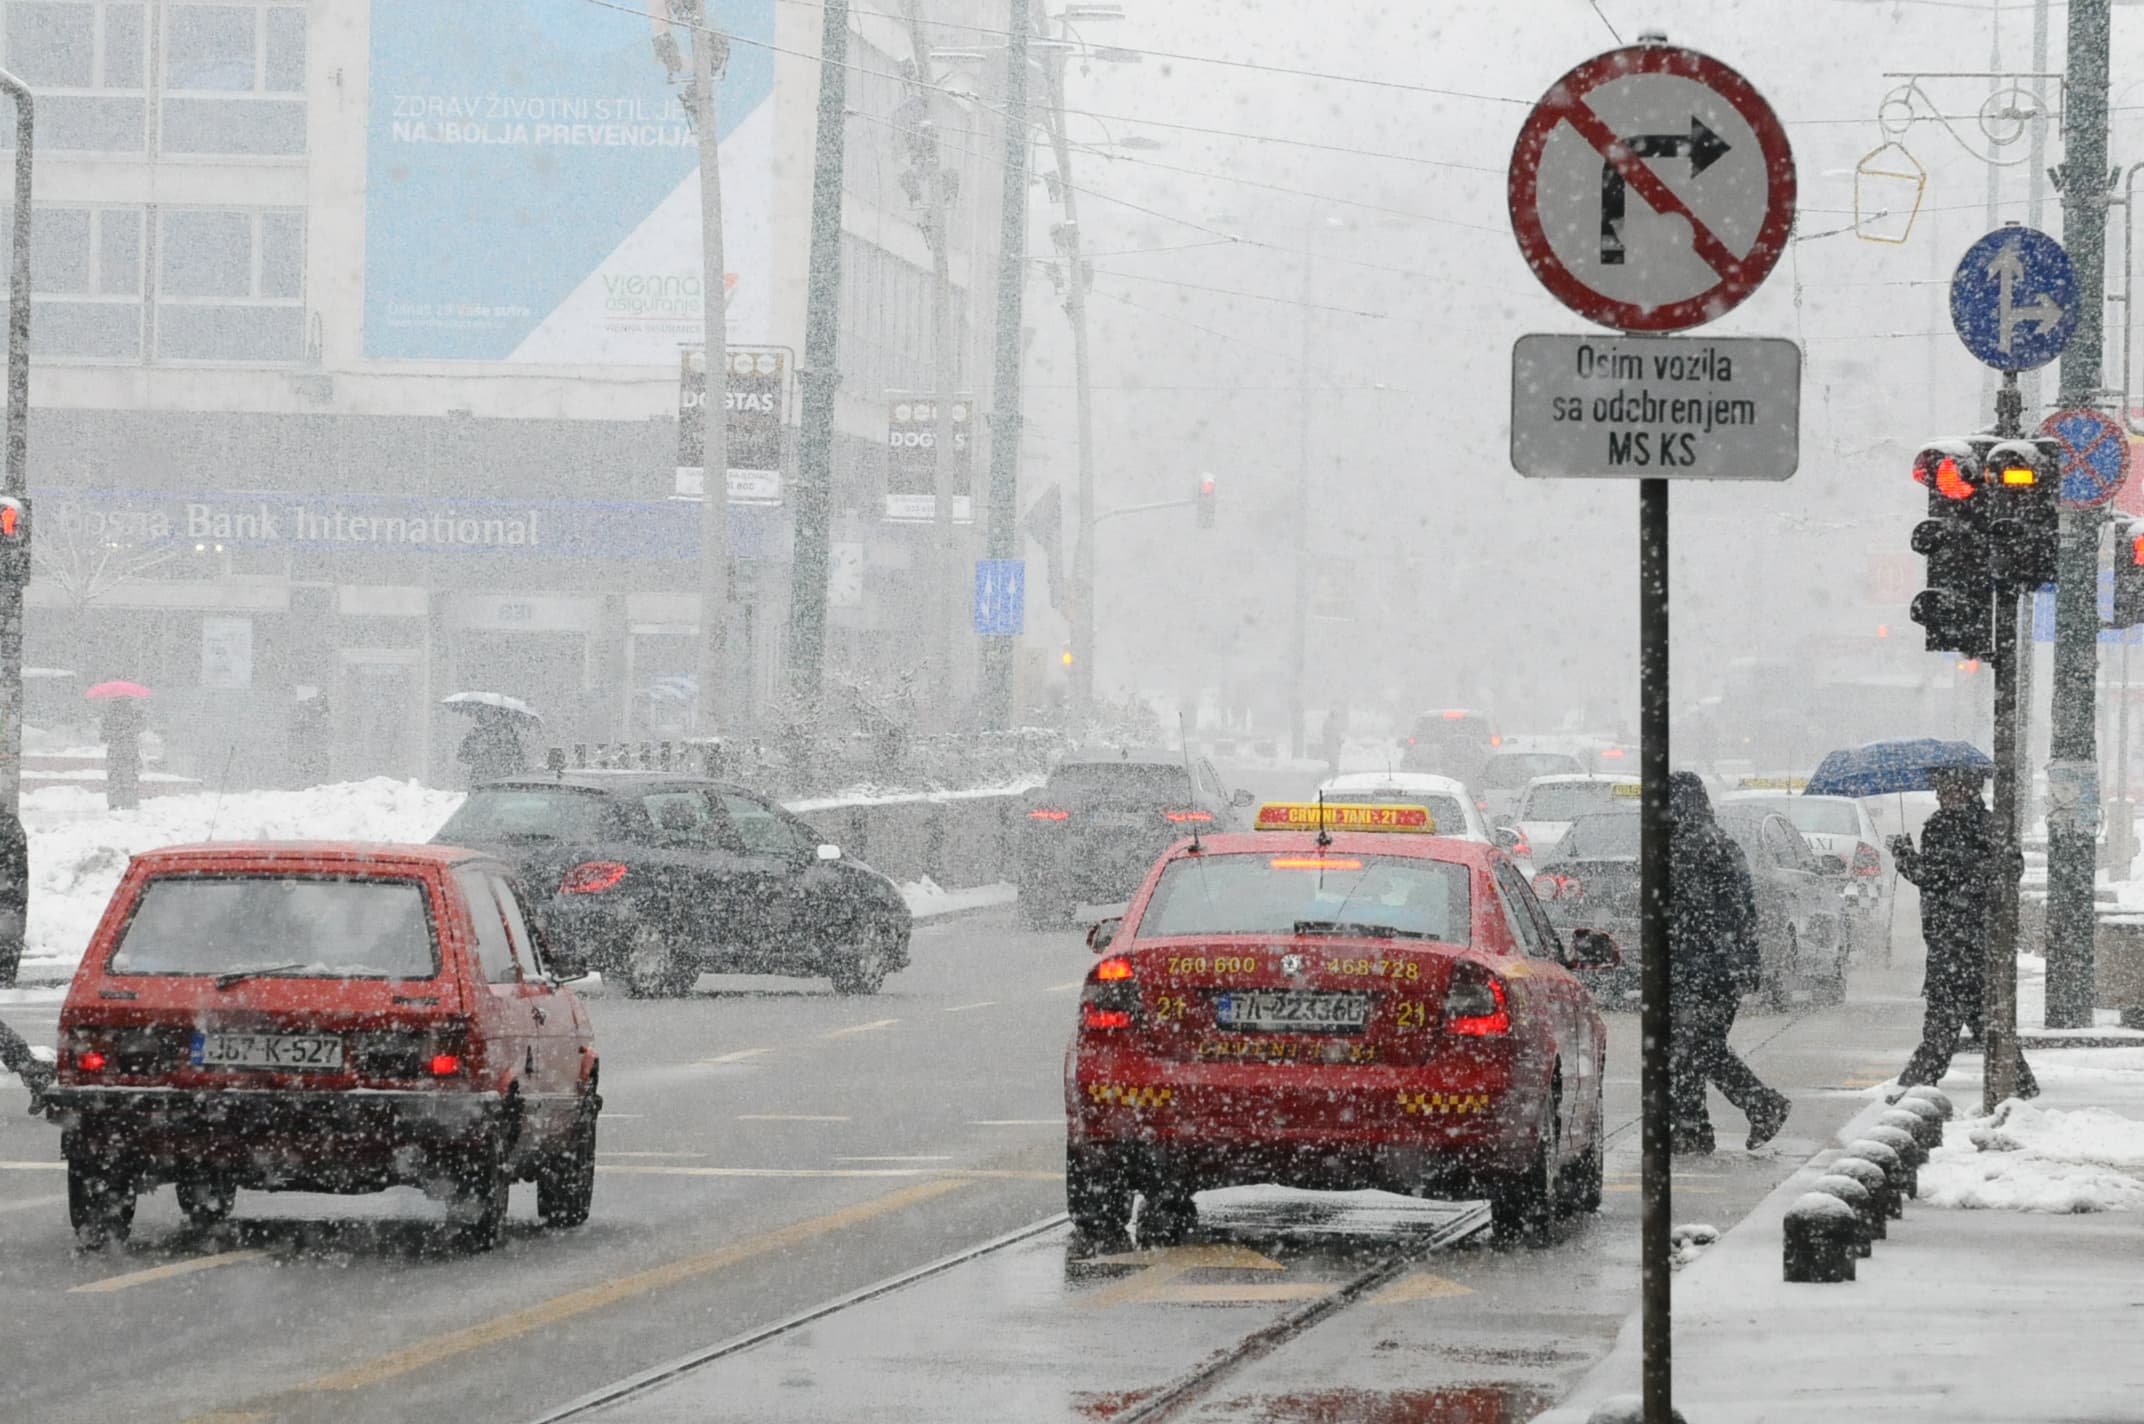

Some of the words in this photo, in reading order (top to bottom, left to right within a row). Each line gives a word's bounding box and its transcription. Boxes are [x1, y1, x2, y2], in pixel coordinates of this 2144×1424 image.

[392, 95, 480, 118] ZDRAV
[486, 90, 588, 120] ŽIVOTNI
[595, 97, 650, 121] STIL
[656, 98, 687, 121] JE
[392, 121, 529, 145] NAJBOLJA
[535, 123, 699, 147] PREVENCIJA
[602, 273, 702, 296] vienna
[1576, 344, 1643, 379] Osim
[1653, 347, 1732, 382] vozila
[1552, 396, 1583, 422] sa
[1592, 389, 1755, 434] odobrenjem
[1608, 431, 1650, 466] MS
[1659, 432, 1697, 467] KS
[186, 503, 280, 538] Bank
[295, 506, 540, 546] International
[1342, 809, 1371, 824] TAXI
[1381, 810, 1397, 825] 21
[1168, 957, 1207, 974] 760
[1327, 958, 1370, 975] 468
[1379, 960, 1419, 979] 728
[1156, 996, 1187, 1020] 21
[1397, 1003, 1425, 1027] 21
[1311, 1042, 1376, 1059] TXI
